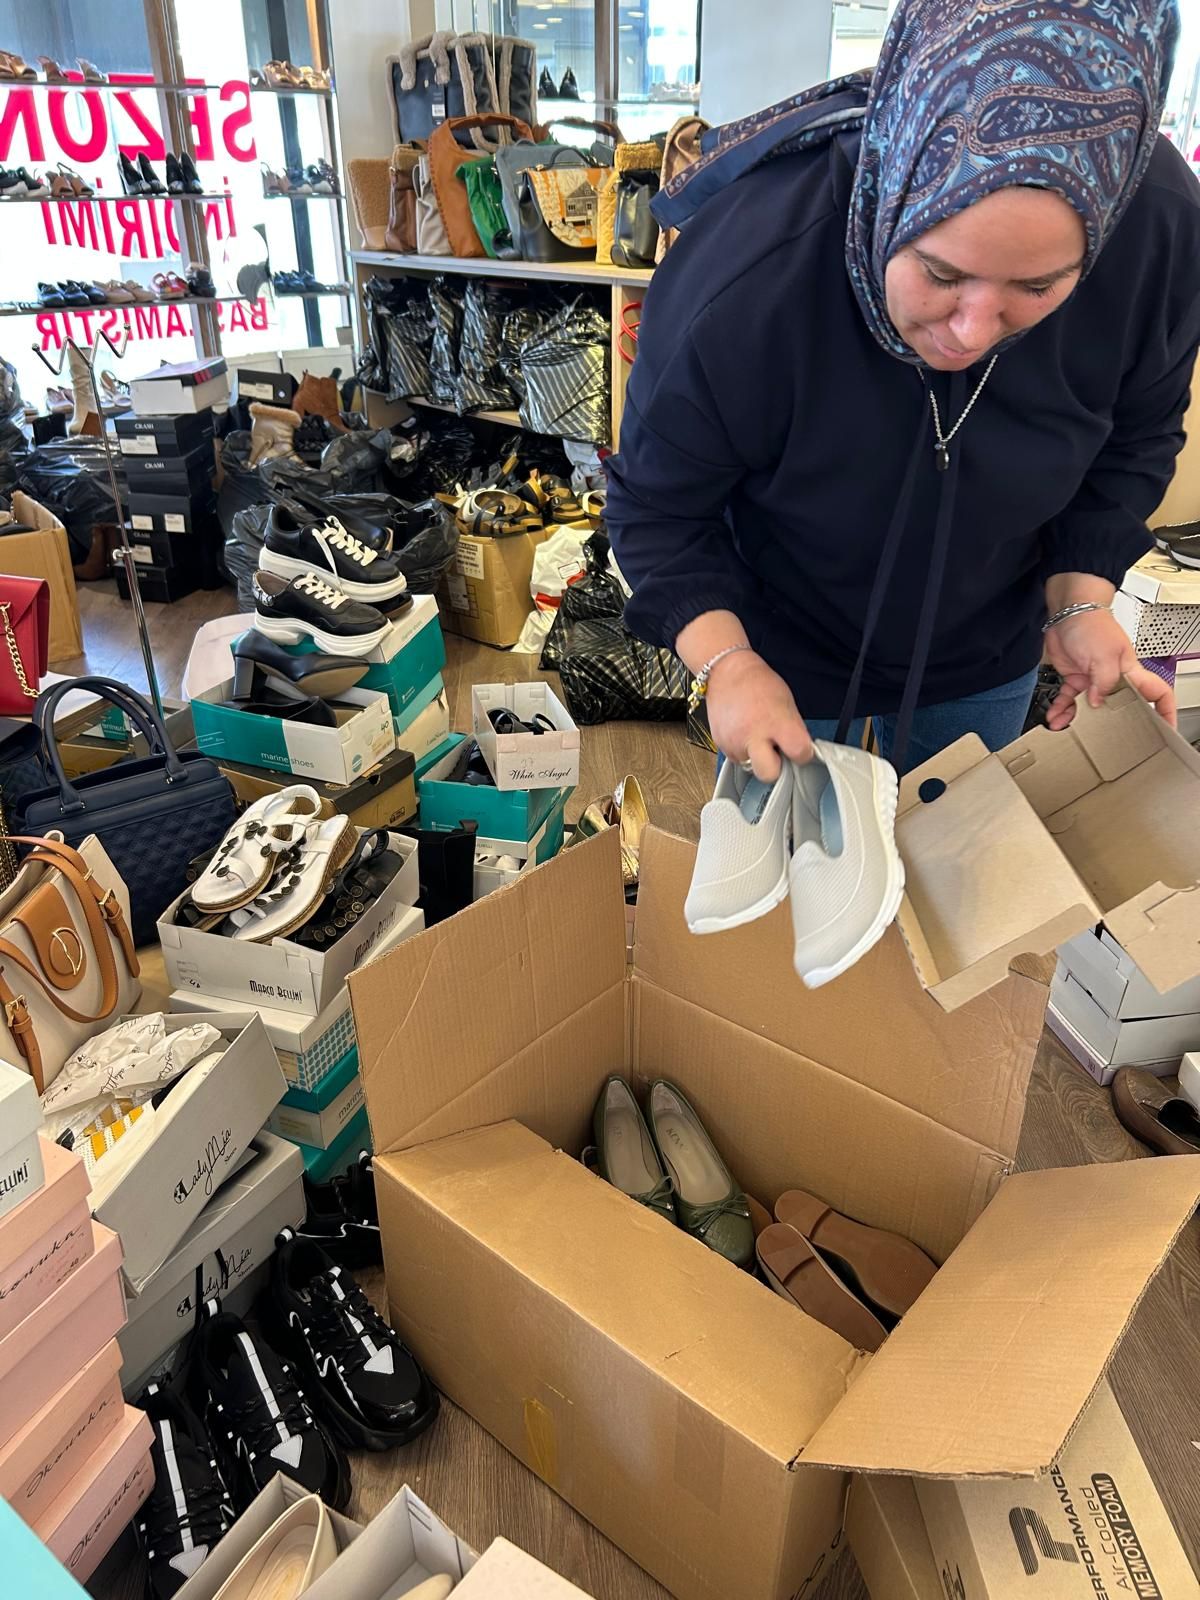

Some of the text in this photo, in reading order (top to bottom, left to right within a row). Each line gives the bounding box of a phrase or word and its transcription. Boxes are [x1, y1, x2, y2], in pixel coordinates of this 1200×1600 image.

[509, 768, 572, 780] White Angel
[1079, 1486, 1133, 1591] Air-Cooled
[1095, 1479, 1159, 1598] MEMORY FOAM
